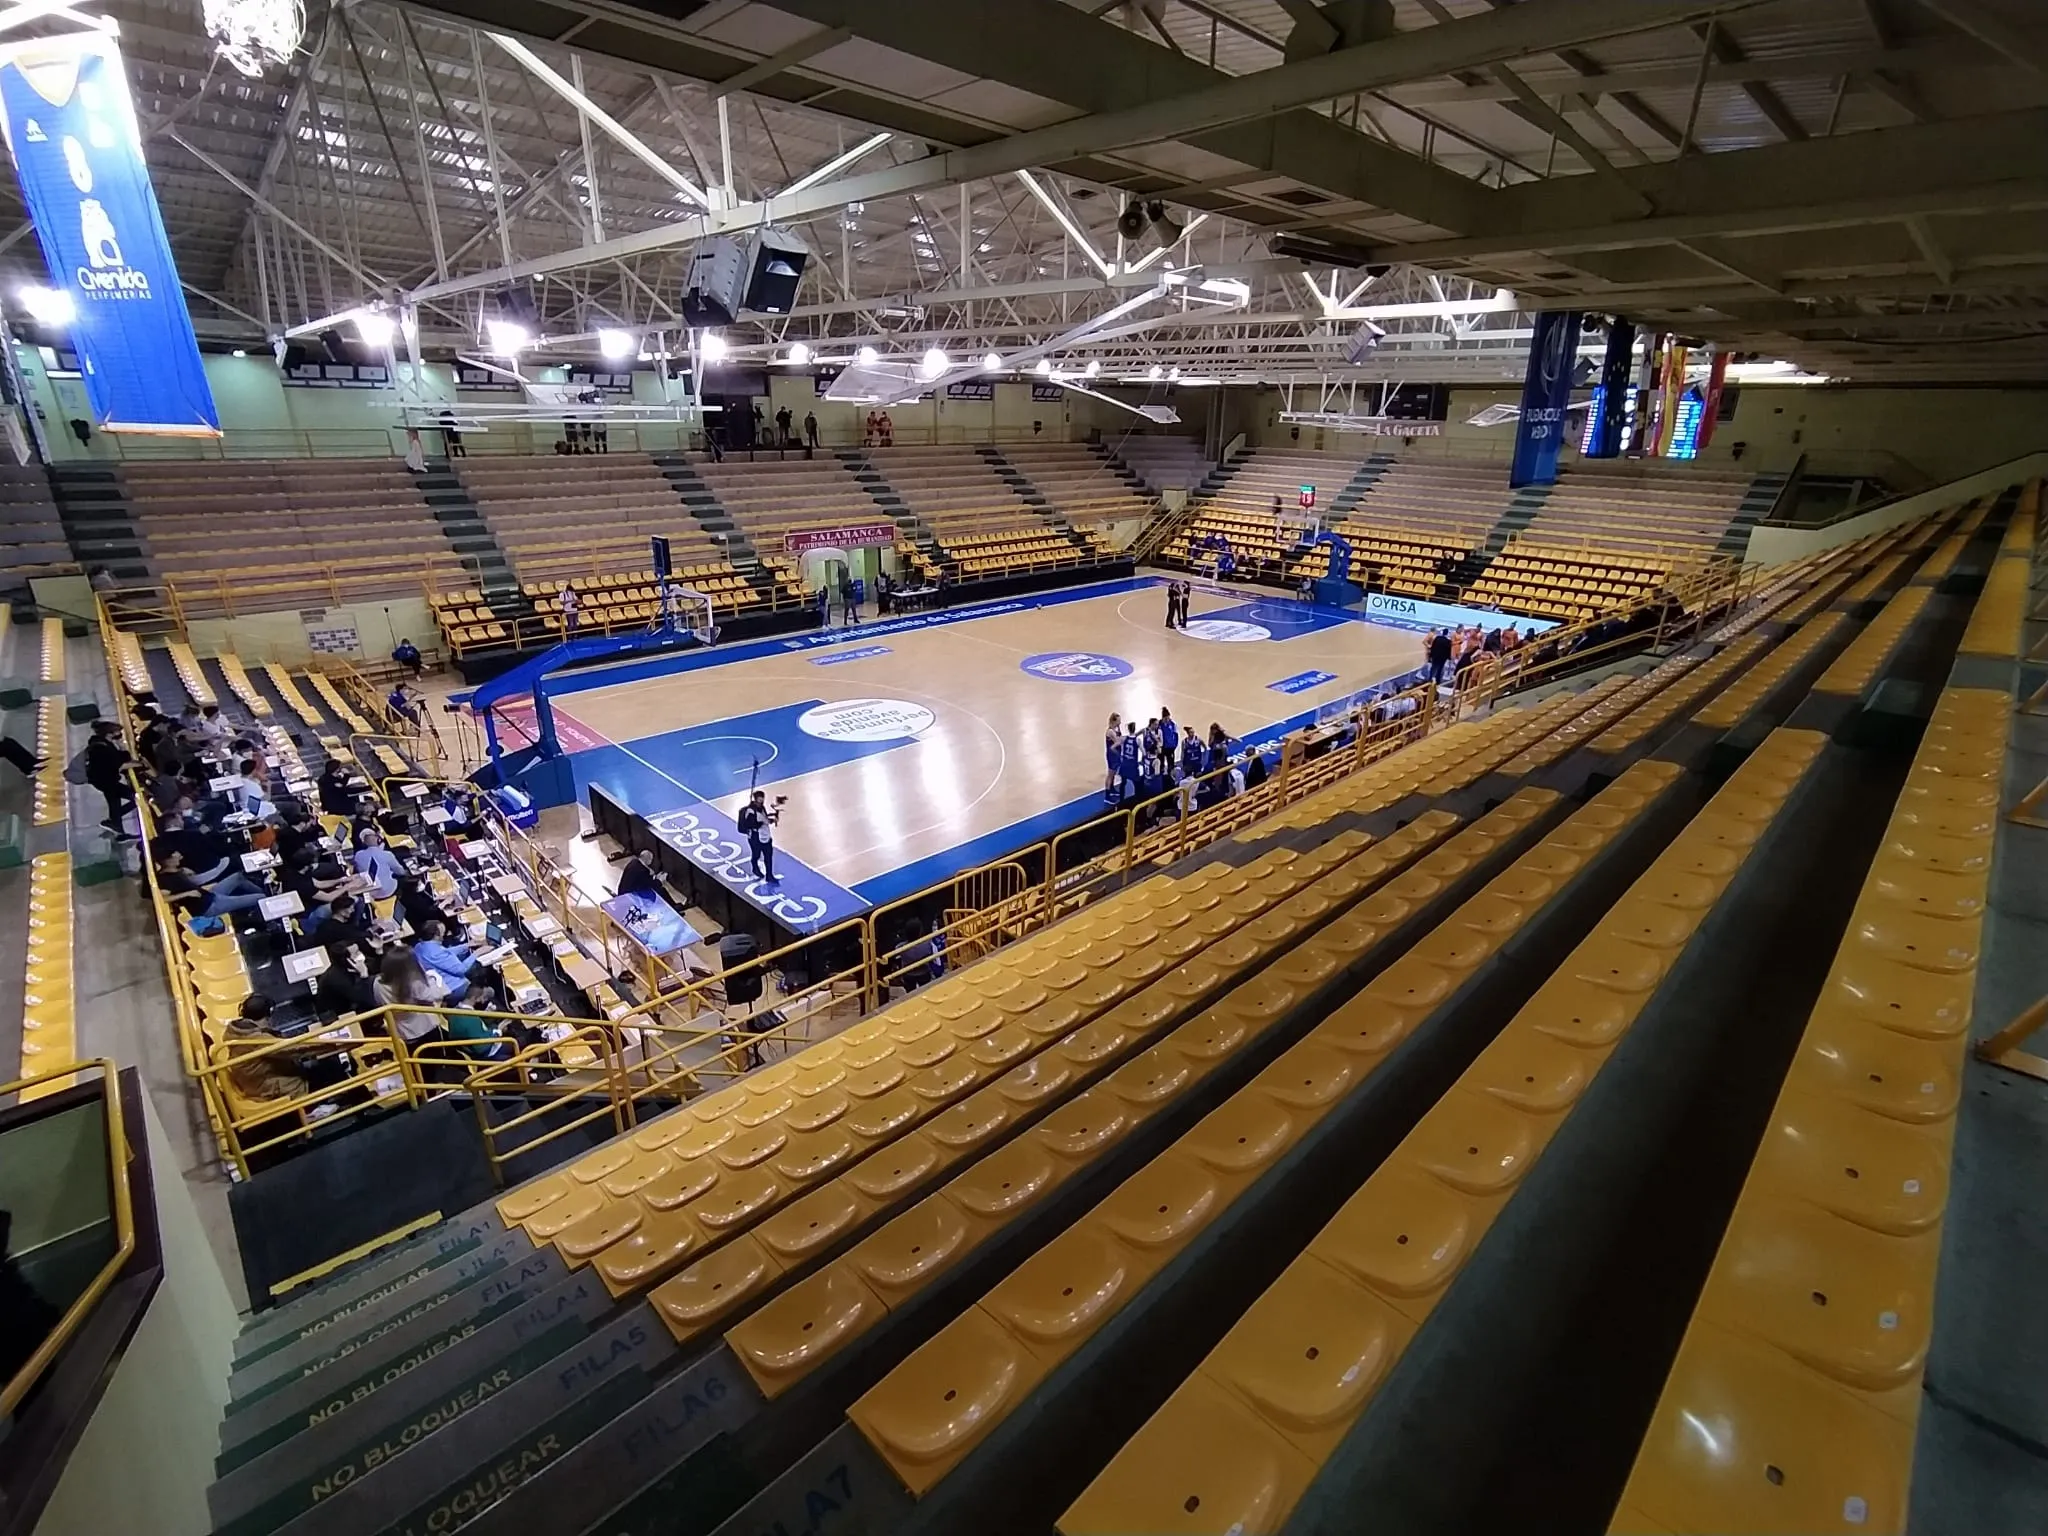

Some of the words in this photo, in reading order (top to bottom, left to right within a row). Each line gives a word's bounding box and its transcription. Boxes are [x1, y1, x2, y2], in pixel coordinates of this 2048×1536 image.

[1376, 423, 1391, 436] LA
[1393, 424, 1440, 436] GACETA
[810, 528, 883, 541] SALAMANCA
[1371, 596, 1416, 614] OYRSA
[808, 618, 926, 643] Ayuntamiento
[927, 614, 945, 624] de
[308, 1400, 346, 1428] NO
[351, 1324, 477, 1401] BLOQUEAR
[311, 1465, 356, 1501] NO
[363, 1368, 512, 1468] BLOQUEAR
